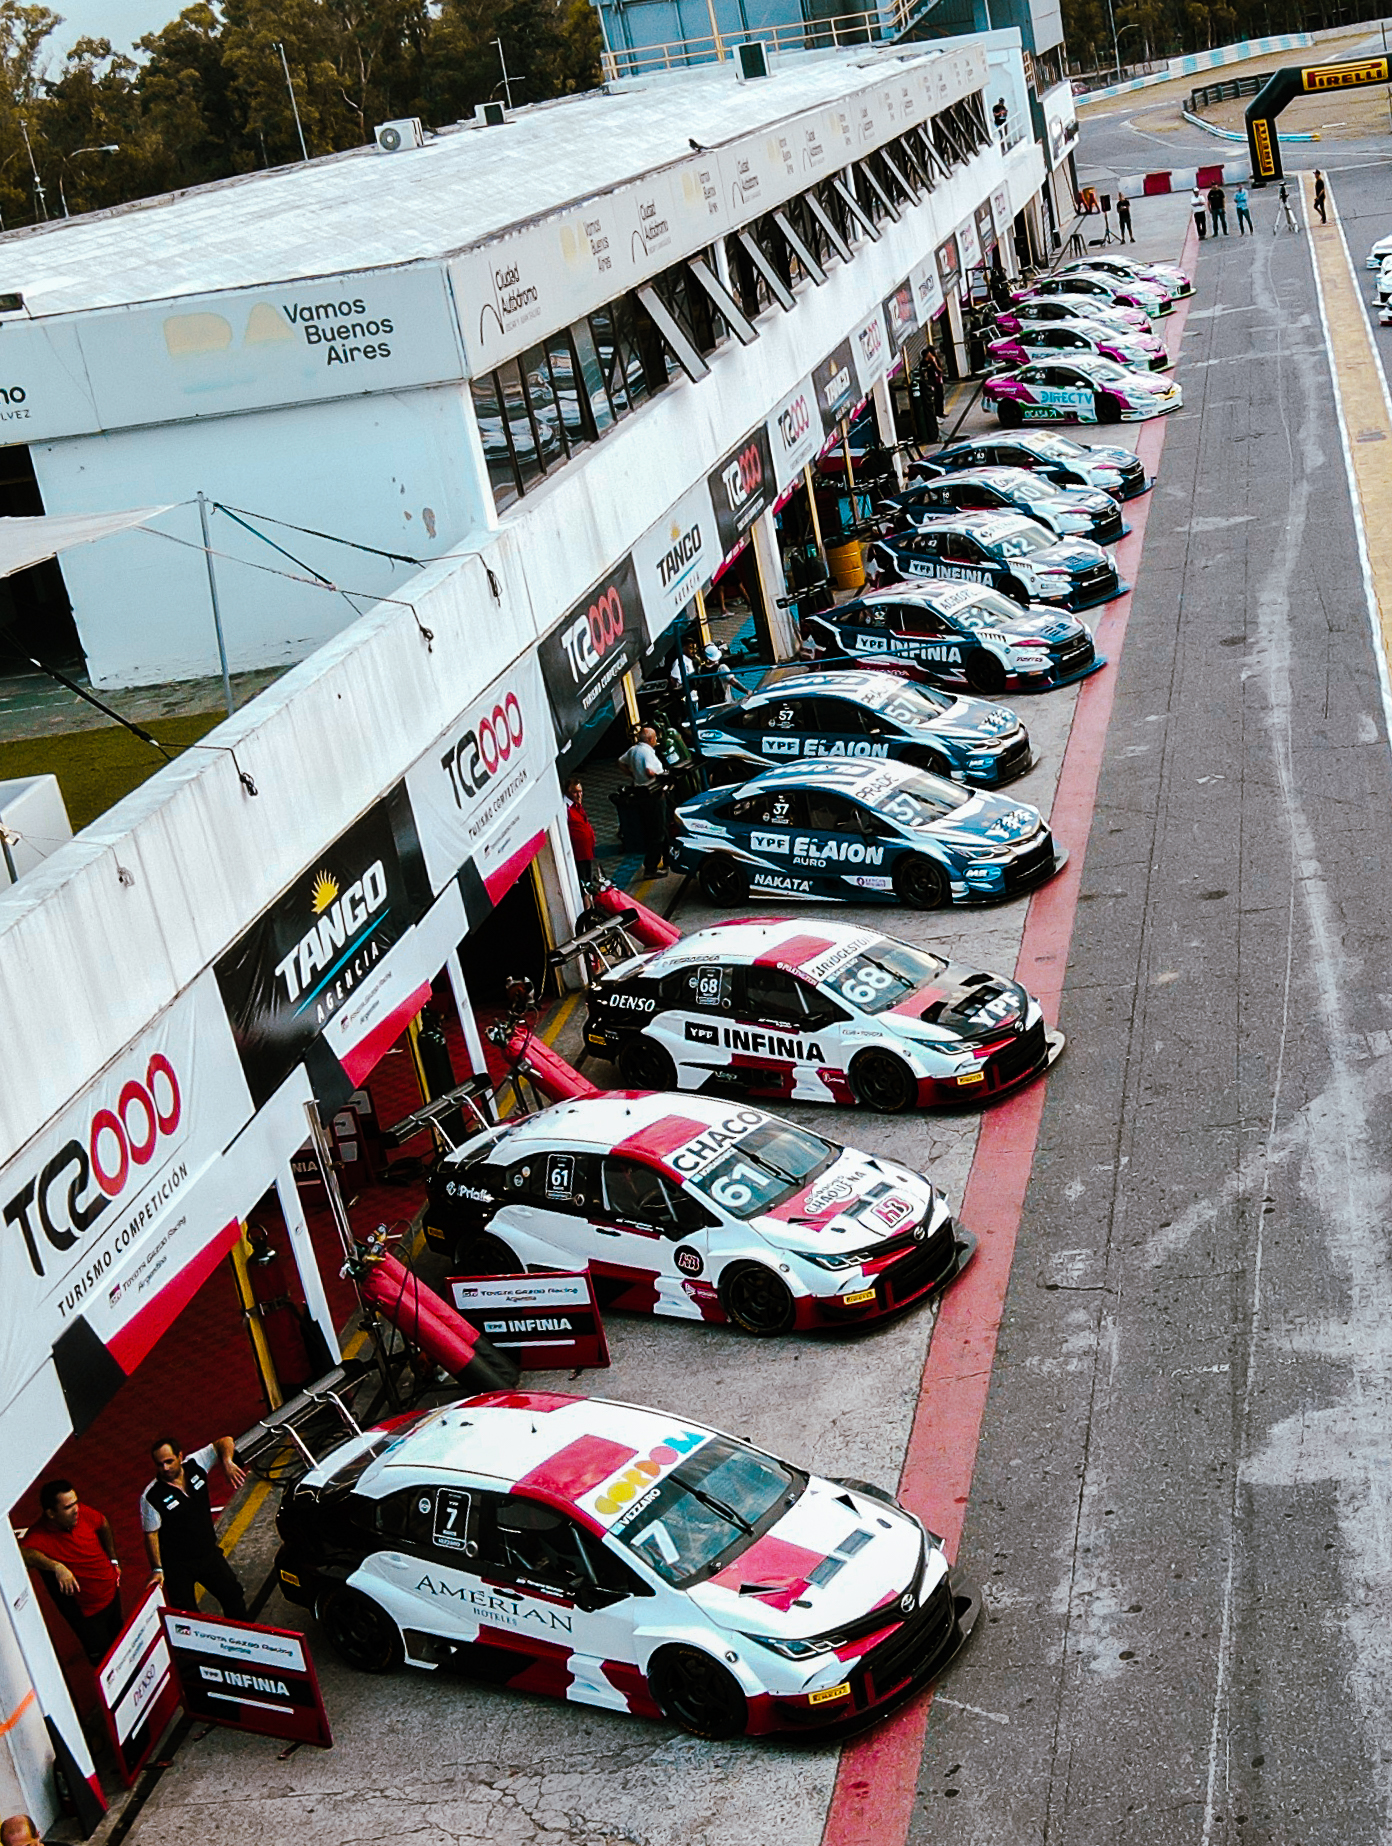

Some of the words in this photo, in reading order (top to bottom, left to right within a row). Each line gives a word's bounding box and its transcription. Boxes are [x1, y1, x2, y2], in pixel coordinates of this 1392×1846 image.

[1307, 62, 1383, 89] PIRELLI
[1255, 121, 1274, 173] PIRELLI
[283, 298, 367, 325] Vamos
[304, 316, 394, 346] Buenos
[326, 341, 392, 366] Aires
[1041, 391, 1092, 404] DIRECTV
[721, 443, 761, 512] TC2000
[1014, 487, 1040, 500] 10
[656, 523, 702, 588] TANGO
[1001, 537, 1036, 558] 42
[936, 564, 993, 587] INFINIA
[560, 585, 624, 683] TC2000
[860, 638, 884, 650] YPF
[890, 638, 962, 664] INFINIA
[779, 710, 794, 721] 57
[884, 700, 918, 722] 57
[441, 691, 524, 810] TC2000
[765, 740, 795, 751] YPF
[803, 738, 889, 758] ELAION
[773, 803, 789, 815] 37
[881, 792, 922, 822] 37
[756, 836, 786, 849] YPF
[794, 836, 884, 865] ELAION
[793, 857, 826, 868] AURO
[754, 873, 808, 891] NAKATA
[275, 859, 388, 1003] TANGO
[316, 941, 380, 1024] AGENCIA
[700, 977, 718, 993] 68
[842, 966, 893, 1004] 68
[609, 994, 655, 1012] DENSO
[968, 991, 1021, 1028] YPF
[689, 1027, 713, 1039] YPF
[724, 1027, 826, 1064] INFINIA
[671, 1110, 763, 1172] CHACO
[2, 1053, 181, 1277] TC2000
[551, 1169, 569, 1186] 61
[710, 1162, 771, 1207] 61
[114, 1161, 189, 1254] COMPETICIÓN
[57, 1253, 112, 1317] TURISMO
[508, 1318, 572, 1332] INFINIA
[446, 1507, 458, 1530] 7
[619, 1488, 661, 1525] VEZZARO
[630, 1519, 681, 1565] 7
[415, 1574, 573, 1633] AMERIAN
[473, 1607, 518, 1627] HOTELES
[224, 1670, 290, 1697] INFINIA
[812, 1685, 848, 1703] PIRELLI
